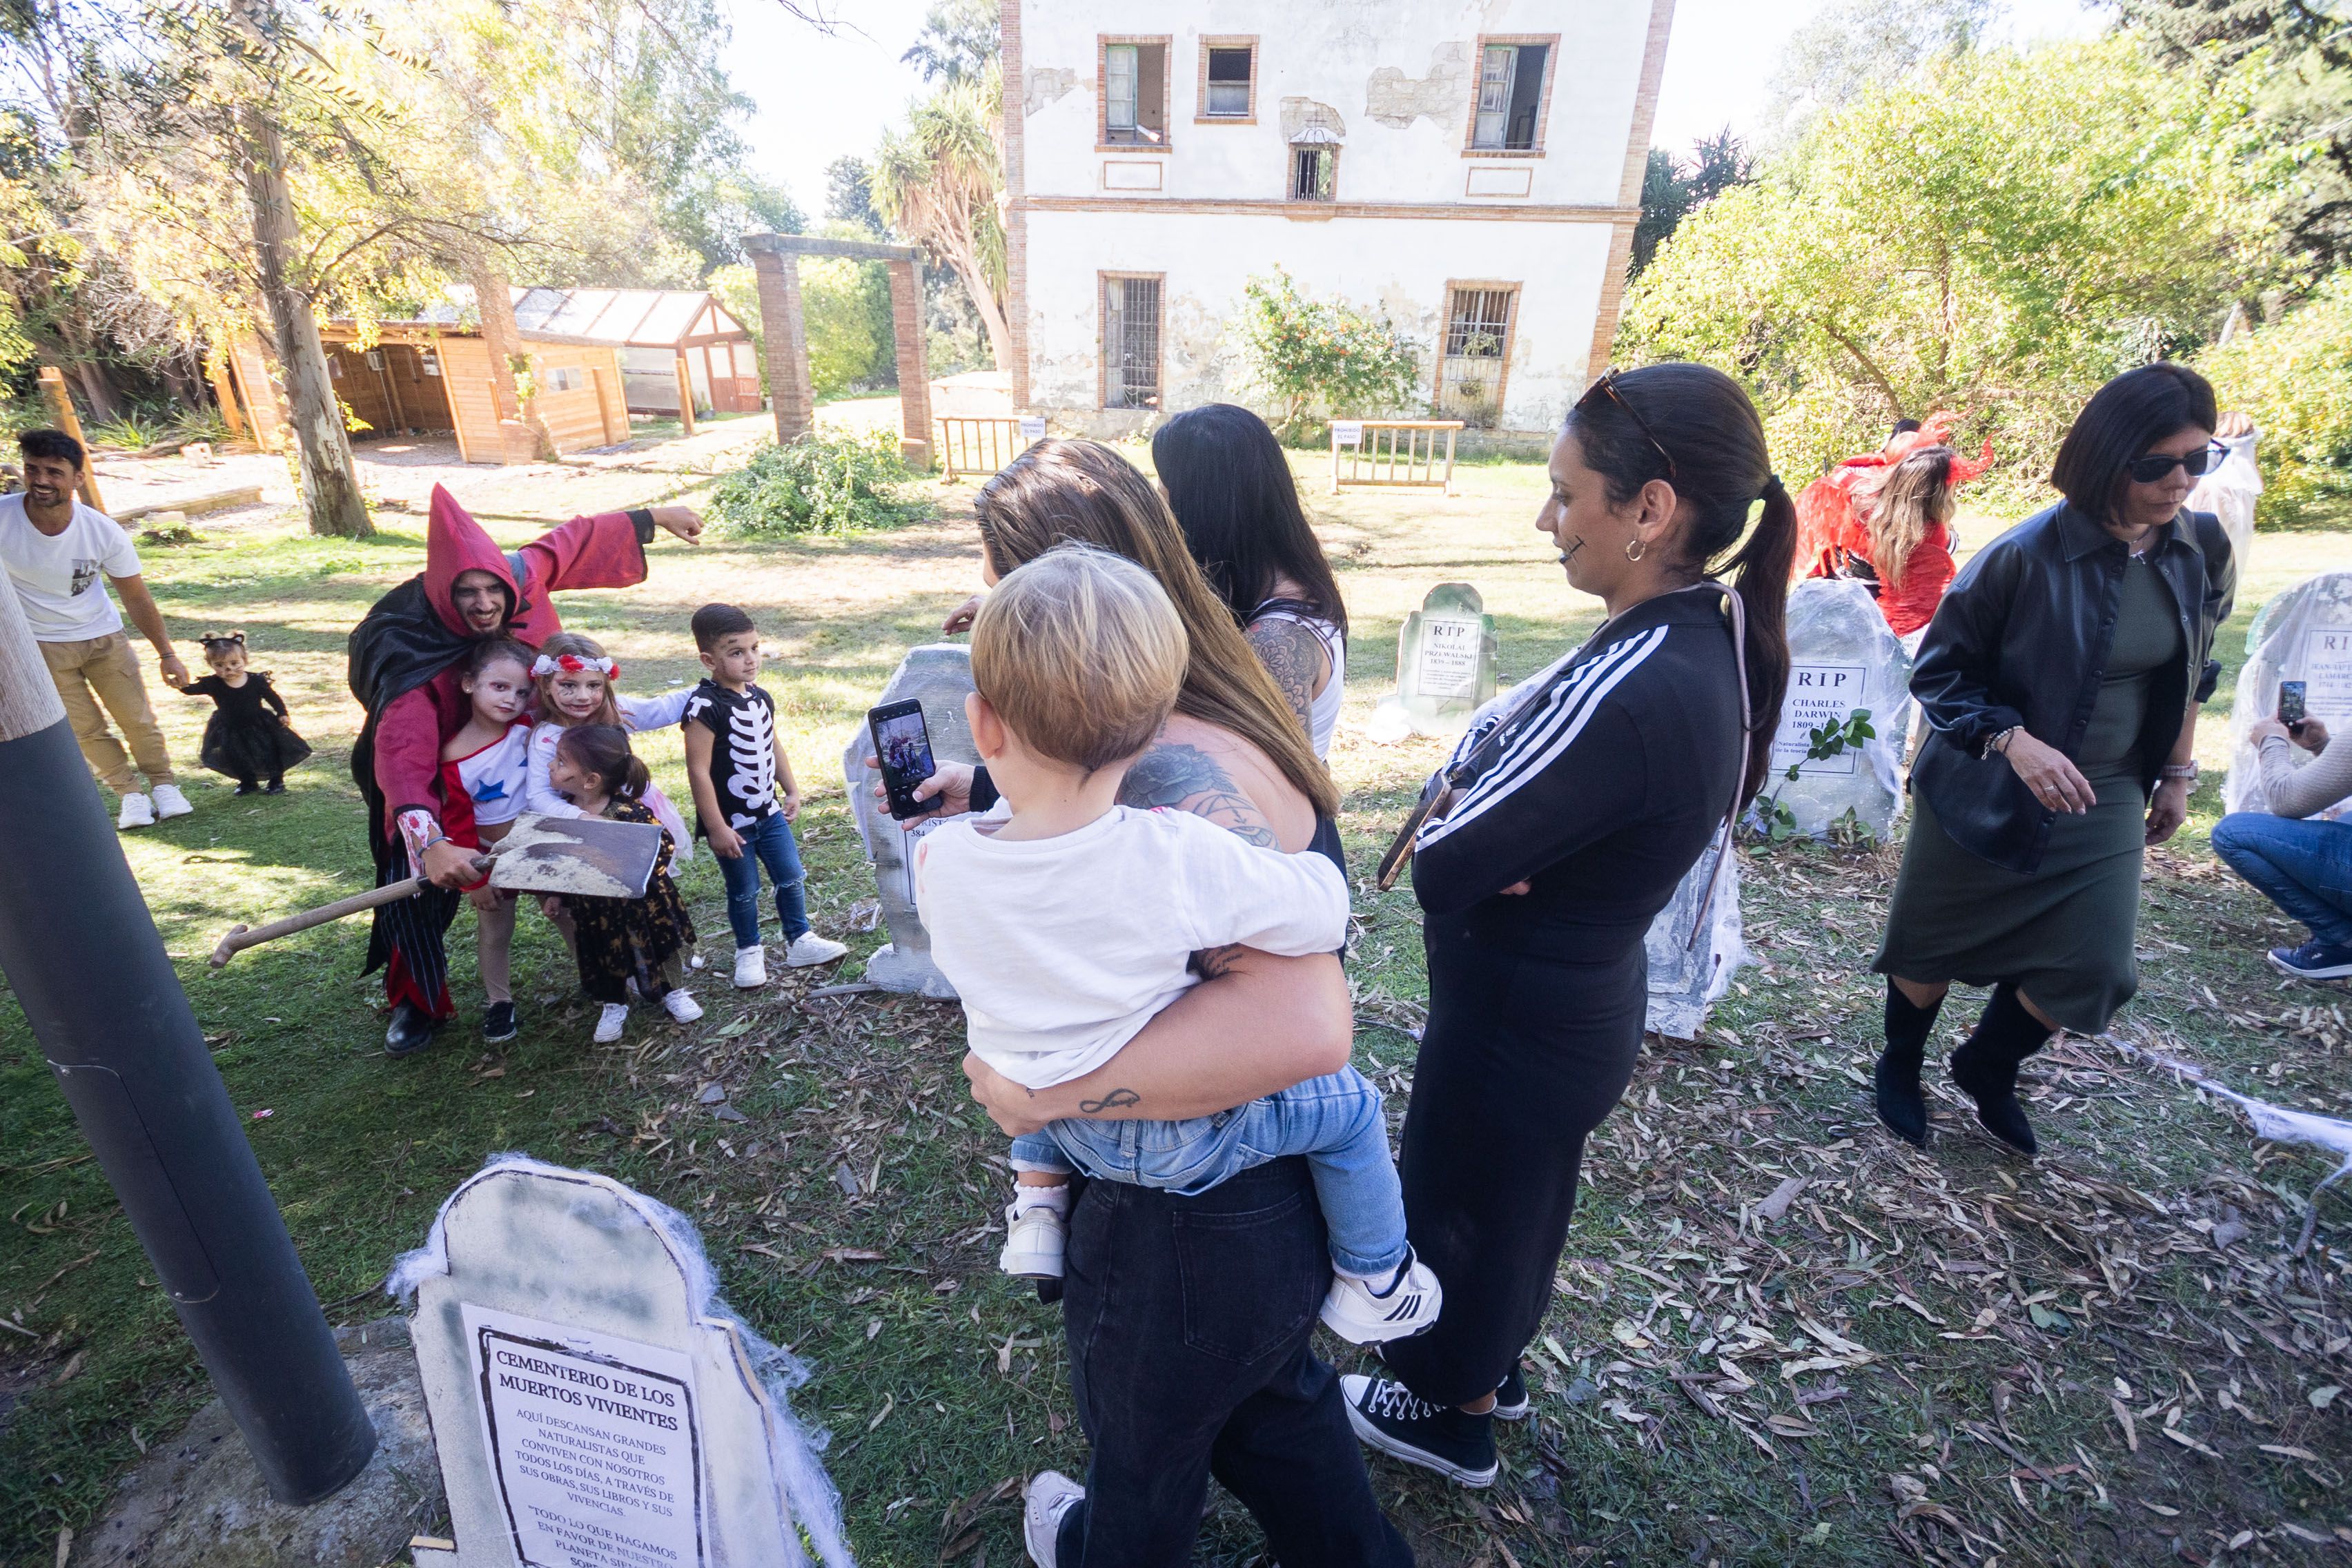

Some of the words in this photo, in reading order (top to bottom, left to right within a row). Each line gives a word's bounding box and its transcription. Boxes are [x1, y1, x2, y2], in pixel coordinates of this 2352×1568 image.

[1792, 698, 1845, 708] CHARLES
[1794, 709, 1841, 719] DARWIN
[497, 1351, 609, 1390] CEMENTERIO
[613, 1379, 638, 1398] DE
[641, 1386, 675, 1407] LOS
[500, 1373, 582, 1406] MUERTOS
[585, 1395, 678, 1431] VIVIENTES
[517, 1409, 545, 1423] AQUÍ
[546, 1415, 611, 1440] DESCANSAN
[613, 1434, 666, 1456] GRANDES
[538, 1428, 619, 1458] NATURALISTAS
[621, 1451, 645, 1465] QUE
[515, 1450, 551, 1468] TODOS
[553, 1461, 573, 1474] LOS
[576, 1467, 603, 1484] DÍAS,
[605, 1476, 614, 1486] A
[614, 1478, 656, 1498] TRAVÉS
[659, 1491, 674, 1503] DE
[522, 1438, 577, 1460] CONVIVEN
[579, 1454, 602, 1468] CON
[605, 1461, 665, 1485] NOSOTROS
[520, 1464, 539, 1478] SUS
[541, 1471, 578, 1490] OBRAS,
[580, 1483, 600, 1496] SUS
[602, 1489, 640, 1508] LIBROS
[642, 1500, 649, 1510] Y
[651, 1504, 673, 1517] SUS
[567, 1492, 626, 1517] VIVENCIAS.
[538, 1521, 553, 1533] EN
[557, 1527, 596, 1547] FAVOR
[598, 1541, 614, 1553] DE
[555, 1539, 608, 1563] PLANETA
[569, 1518, 584, 1530] LO
[587, 1524, 613, 1539] QUE
[615, 1533, 677, 1560] HAGAMOS
